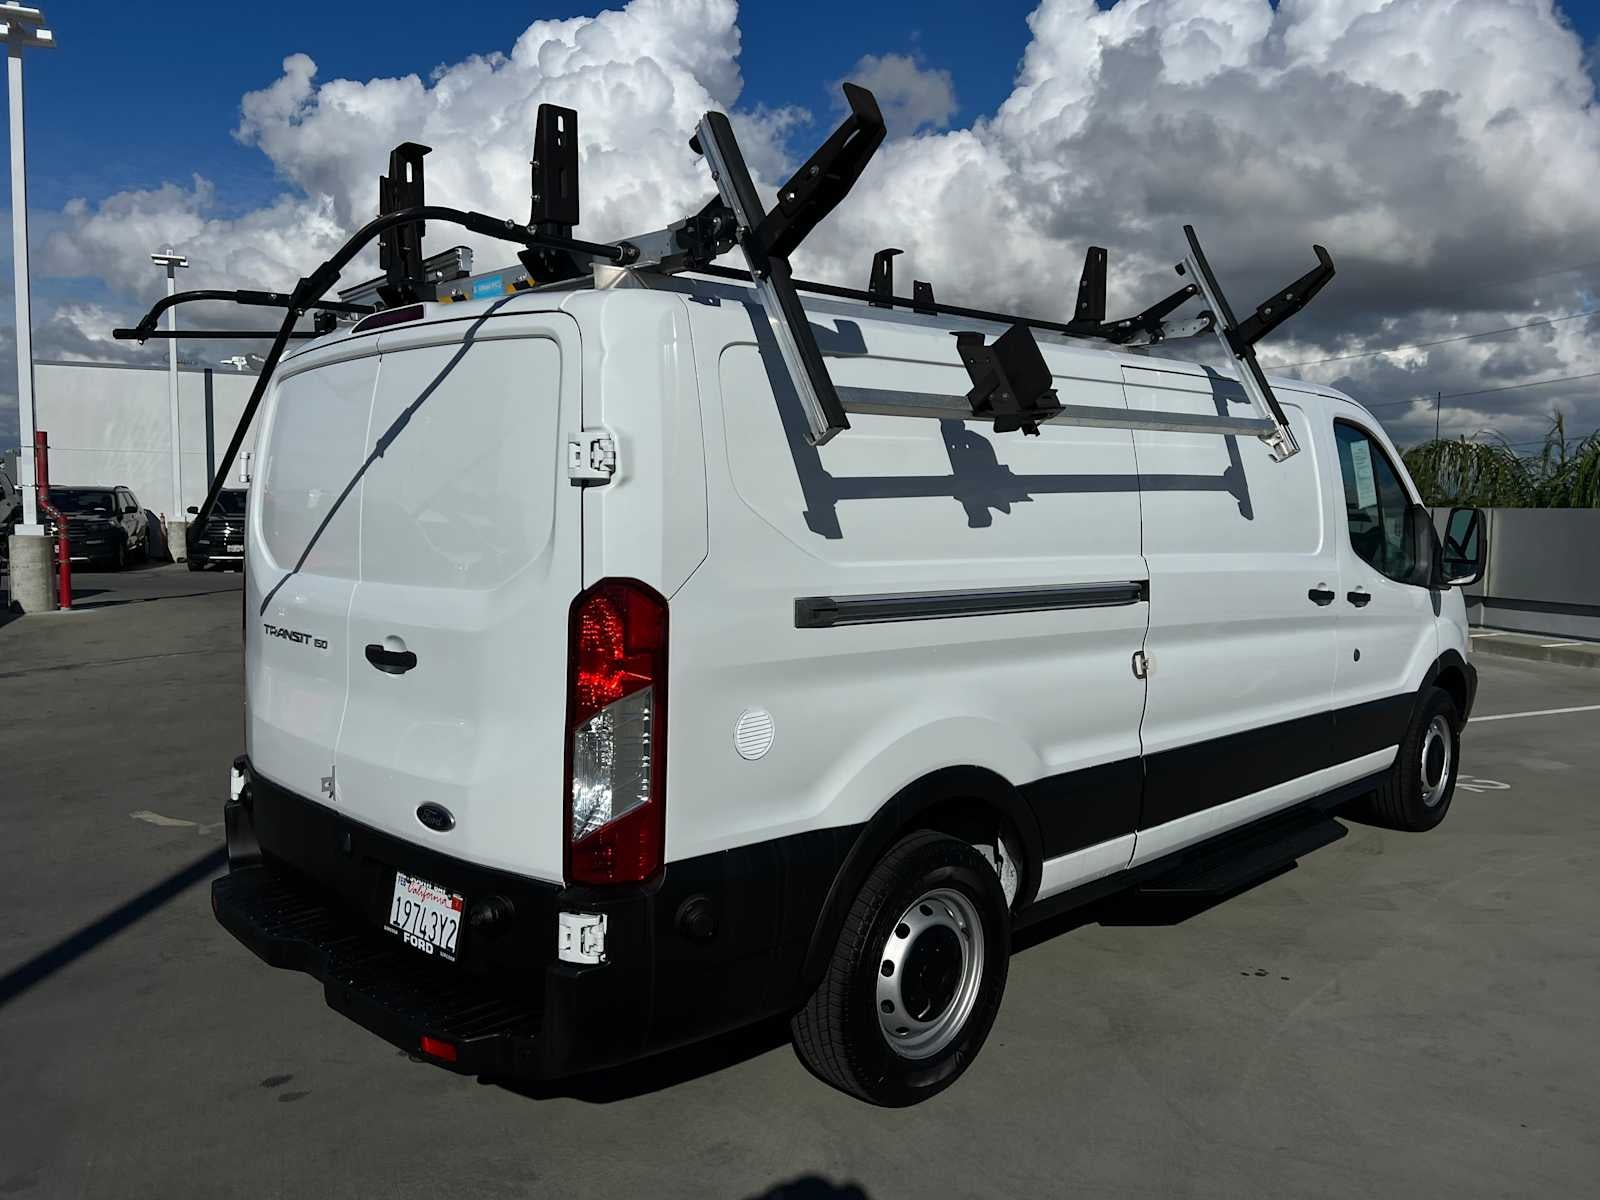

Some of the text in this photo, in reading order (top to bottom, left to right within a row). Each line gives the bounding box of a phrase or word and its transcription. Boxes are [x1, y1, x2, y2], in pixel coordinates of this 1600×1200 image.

[263, 623, 328, 649] TRANSIT 150
[407, 881, 449, 908] California
[392, 896, 457, 952] 19743Y2
[403, 931, 434, 955] FORD
